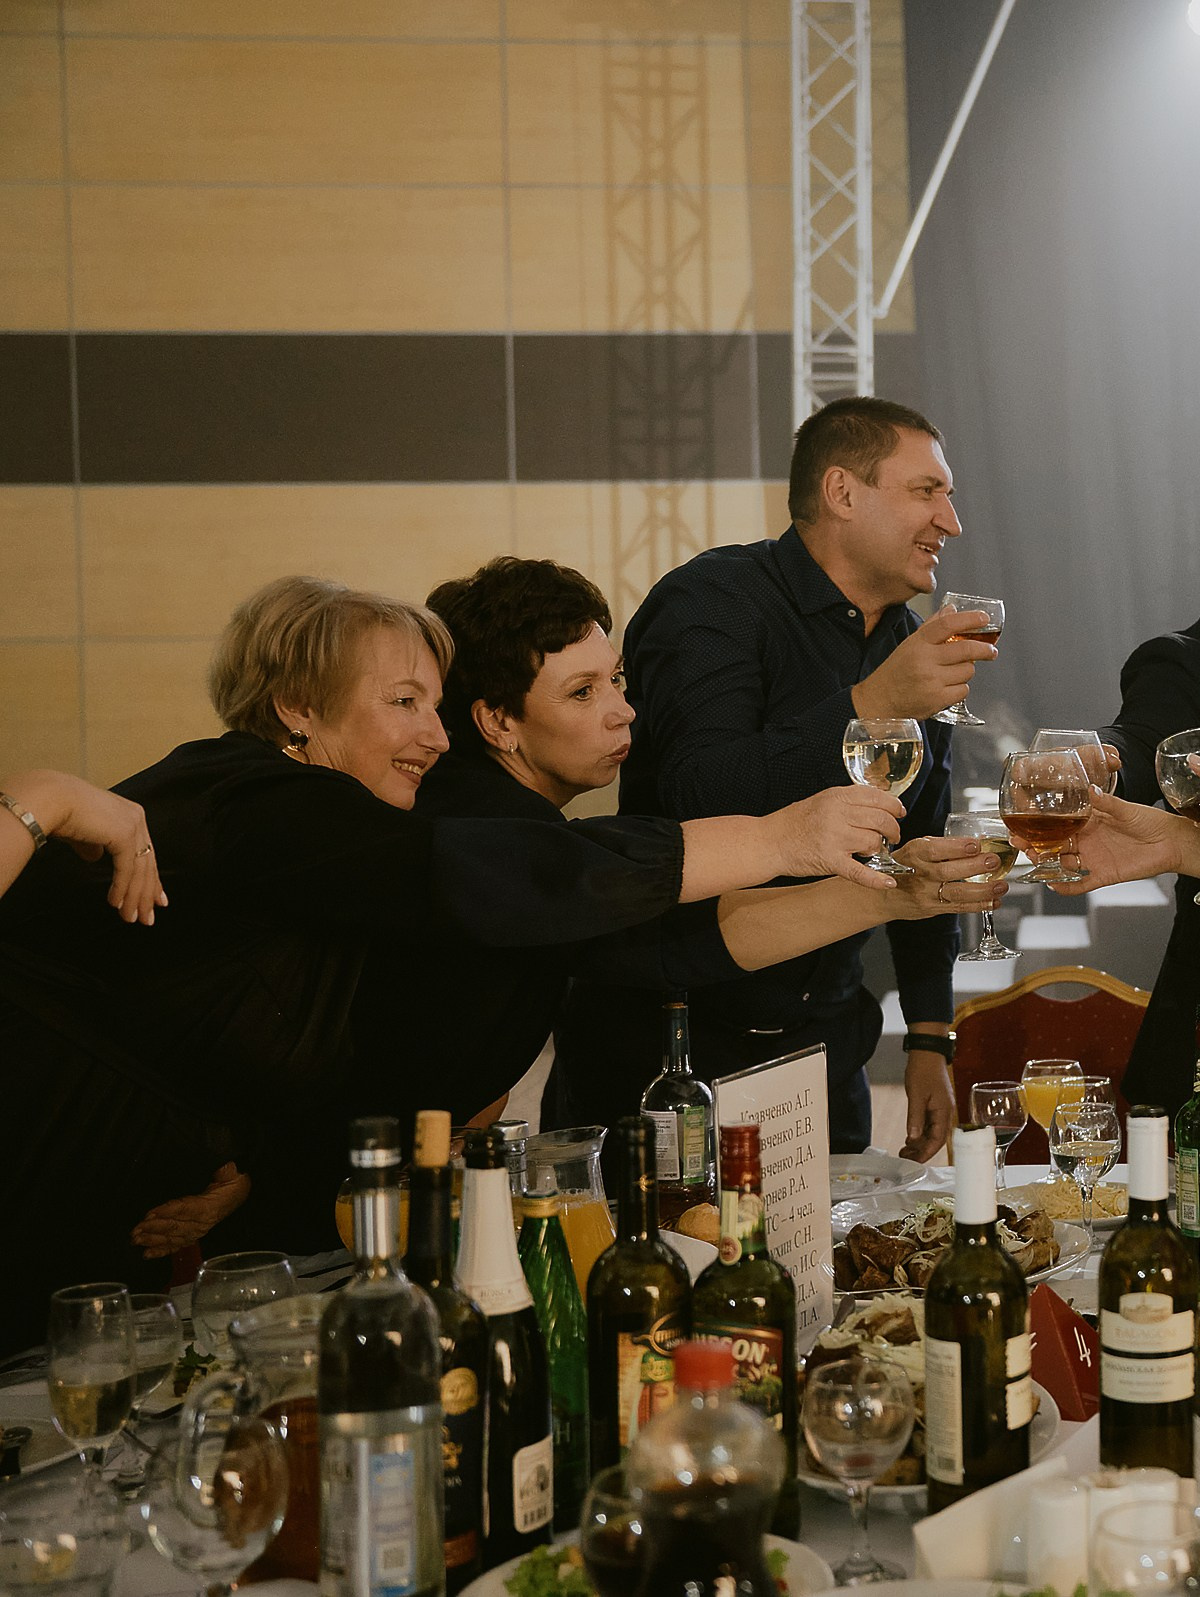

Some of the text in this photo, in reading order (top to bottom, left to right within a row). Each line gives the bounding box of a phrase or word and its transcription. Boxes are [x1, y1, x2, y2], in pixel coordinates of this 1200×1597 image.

[795, 1089, 813, 1110] А.Г.
[760, 1116, 814, 1151] вченко Е.В.
[760, 1144, 815, 1179] вченко Д.А.
[763, 1174, 808, 1212] рнев Р.А.
[765, 1213, 779, 1234] ТС
[789, 1206, 794, 1222] 4
[797, 1202, 815, 1218] чел.
[794, 1225, 814, 1249] С.Н.
[797, 1280, 818, 1305] Д.А.
[1073, 1326, 1091, 1368] 4
